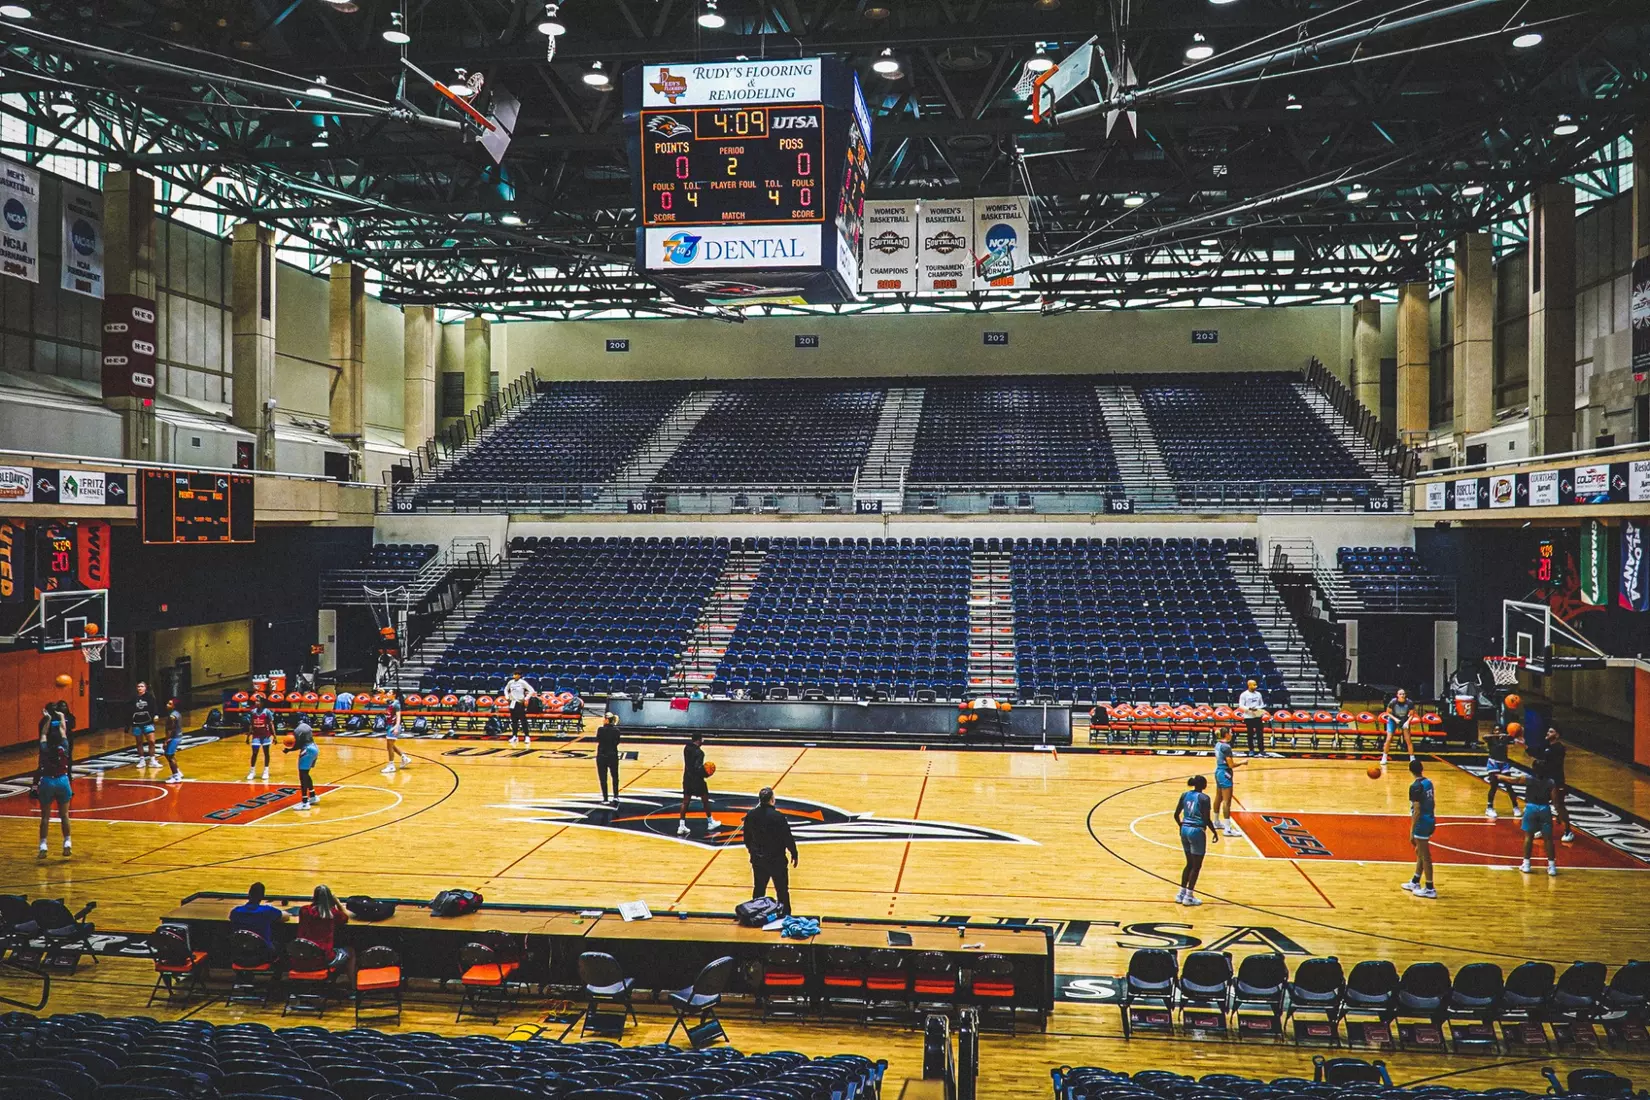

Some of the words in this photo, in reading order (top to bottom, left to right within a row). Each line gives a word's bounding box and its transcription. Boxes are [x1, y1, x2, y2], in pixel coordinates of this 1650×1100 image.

[693, 67, 743, 79] RUDY'S
[745, 65, 813, 77] FLOORING
[747, 79, 756, 87] &
[709, 87, 796, 101] REMODELING
[714, 111, 764, 135] 4:09
[772, 116, 818, 129] UTSA
[655, 142, 690, 153] POINTS
[779, 138, 804, 150] POSS
[719, 146, 745, 155] PERIOD
[675, 156, 689, 179] 0
[727, 157, 738, 176] 2
[797, 152, 811, 176] 0
[652, 182, 675, 191] FOULS
[710, 181, 737, 189] PLAYER
[738, 181, 757, 189] FOUL
[791, 179, 815, 187] FOULS
[661, 191, 673, 210] 0
[687, 192, 698, 207] 4
[768, 190, 780, 206] 4
[800, 188, 811, 206] 0
[874, 207, 906, 215] WOMEN'S
[930, 207, 961, 215] WOMEN'S
[986, 203, 1018, 211] WOMEN'S
[653, 213, 676, 222] SCORE
[721, 211, 746, 220] MATCH
[791, 209, 815, 218] SCORE
[981, 212, 1022, 221] BASKETBALL
[870, 215, 910, 223] BASKETBALL
[926, 215, 966, 223] BASKETBALL
[3, 235, 28, 253] NCAA
[870, 238, 909, 248] SOUTHLAND
[926, 238, 965, 248] SOUTHLAND
[705, 239, 805, 261] DENTAL
[870, 267, 909, 275] CHAMPIONS
[928, 270, 963, 278] CHAMPIONS
[987, 334, 1005, 342] 202
[1195, 332, 1214, 340] 203
[799, 337, 815, 345] 201
[82, 477, 104, 489] FRITZ
[1576, 474, 1607, 485] COLDFIRE
[80, 488, 104, 496] KENNEL
[396, 502, 412, 510] 100
[1112, 502, 1130, 510] 103
[1370, 501, 1389, 509] 104
[87, 526, 101, 582] WKU
[0, 524, 14, 597] UTEP
[1591, 520, 1600, 604] CHARLOTTE
